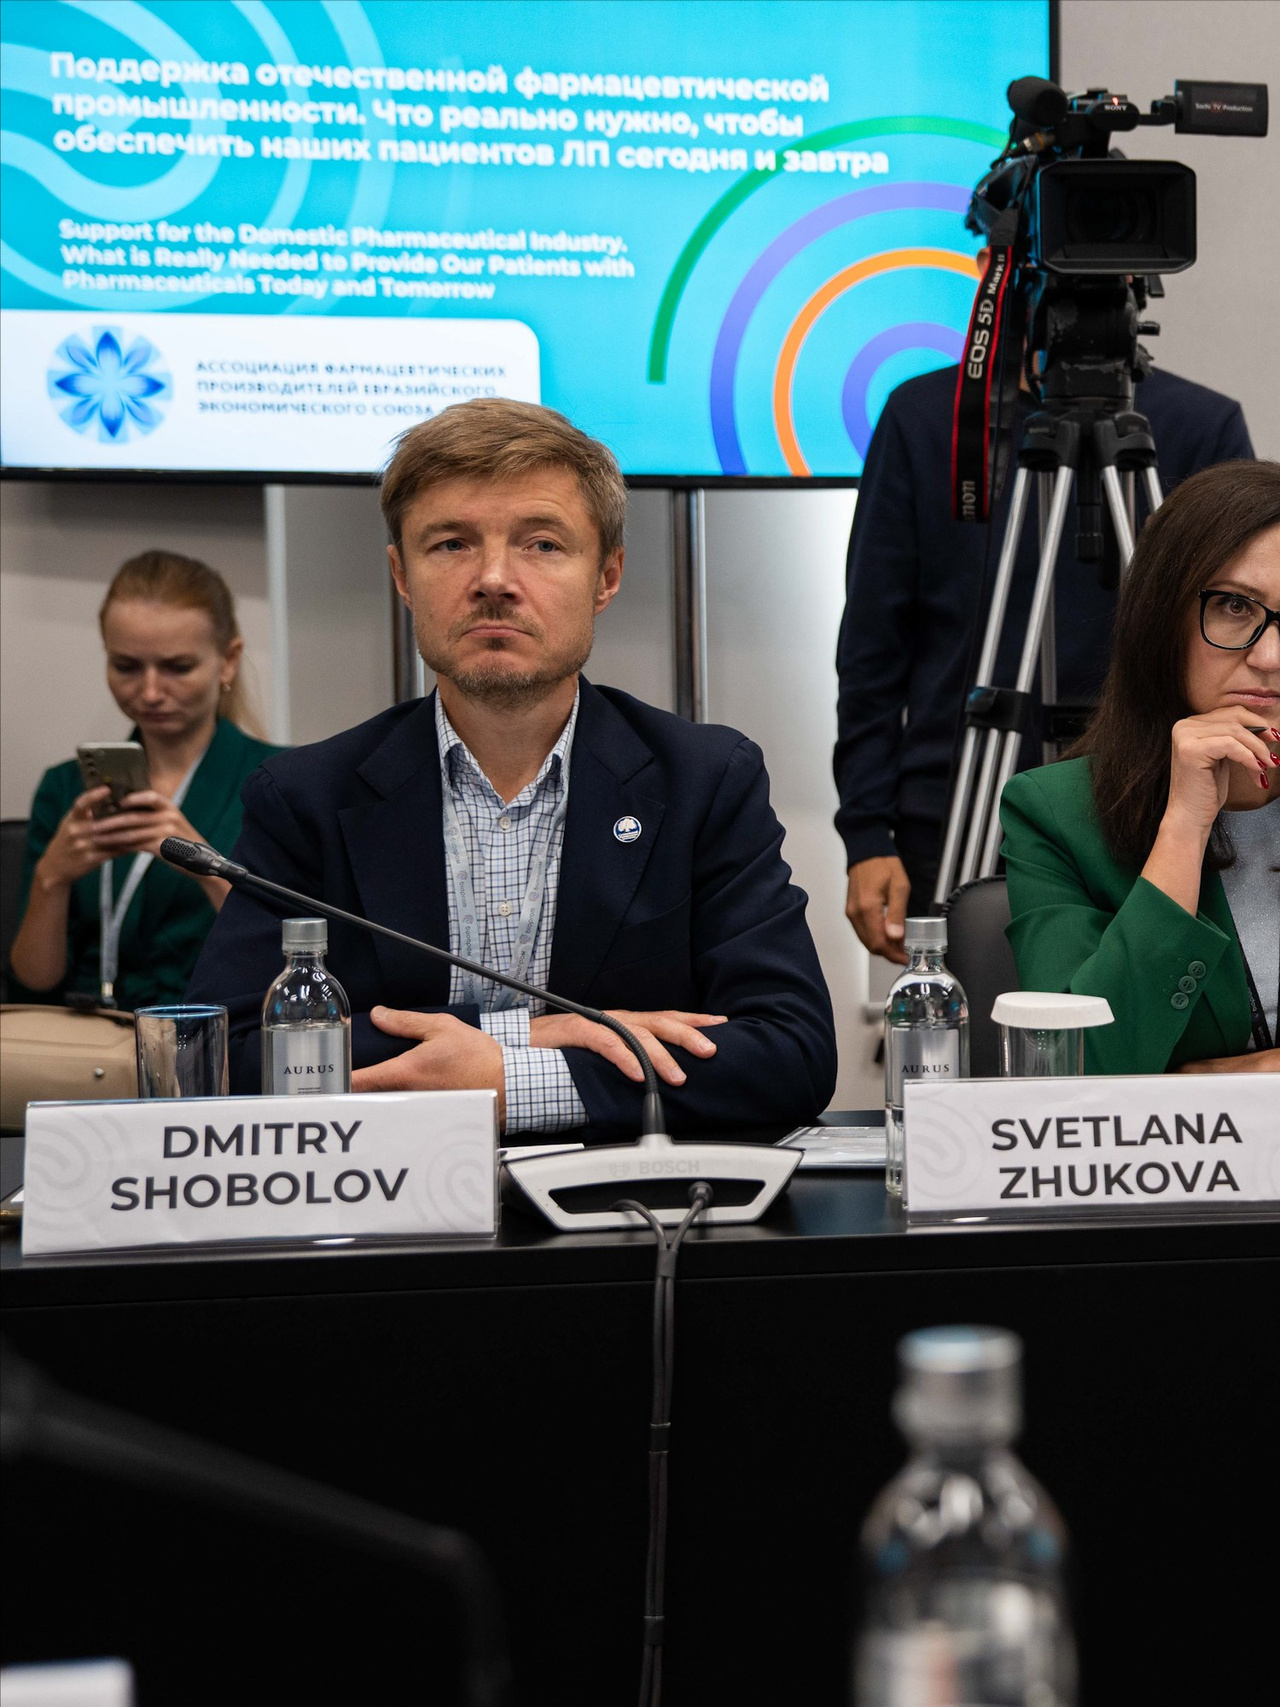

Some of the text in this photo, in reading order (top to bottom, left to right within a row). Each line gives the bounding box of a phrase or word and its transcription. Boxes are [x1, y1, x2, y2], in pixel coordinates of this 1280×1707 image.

[50, 51, 829, 102] Поддержка отечественной фармацевтической
[52, 93, 804, 139] промышленности. Что реально нужно, чтобы
[53, 124, 889, 179] обеспечить наших пациентов ЛП сегодня и завтра
[58, 218, 154, 244] Support
[156, 220, 192, 243] for
[193, 221, 236, 244] the
[238, 223, 348, 247] Domestic
[351, 225, 527, 250] Pharmaceutical
[60, 243, 635, 278] What is Really Needed to Provide Our Patients with
[62, 268, 495, 300] Pharmaceuticals Today and Tomorrow
[987, 261, 1005, 295] Mark
[977, 299, 994, 326] 5D
[196, 360, 506, 377] АССОЦИАЦИЯ ФАРМАЦЕВТИЧЕСКИХ
[968, 329, 990, 379] EOS
[197, 380, 496, 397] ПРОИЗВОДИТЕЛЕЙ ЕВРАЗИЙСКОГО
[198, 399, 434, 416] ЭКОНОМИЧЕСКОГО СОЮЗА
[963, 480, 976, 521] non
[283, 1064, 334, 1075] AURUS
[902, 1064, 950, 1073] AURUS
[163, 1120, 362, 1159] DMITRY
[991, 1112, 1242, 1151] SVETLANA
[639, 1160, 700, 1175] BOSCH
[999, 1160, 1240, 1200] ZHUKOVA
[110, 1167, 409, 1212] SHOBOLOV
